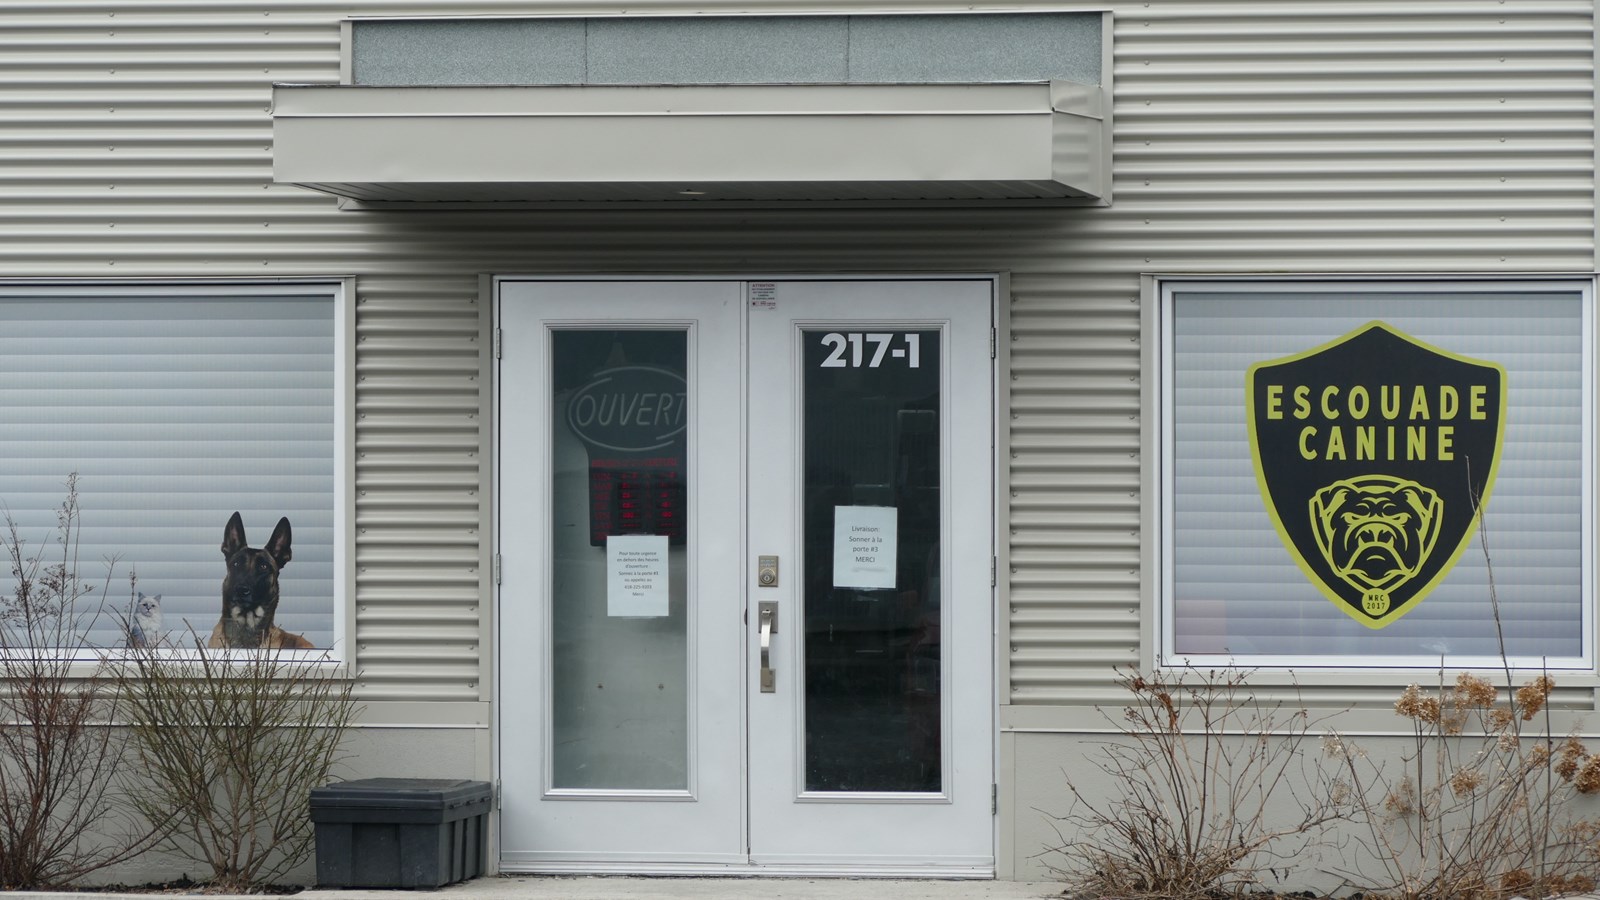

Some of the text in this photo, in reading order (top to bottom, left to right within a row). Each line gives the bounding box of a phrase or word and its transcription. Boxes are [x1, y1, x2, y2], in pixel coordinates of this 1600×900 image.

[820, 332, 920, 368] 217-1
[576, 392, 688, 426] OUVERT
[1267, 385, 1487, 420] ESCOUADE
[1298, 425, 1454, 461] CANINE
[848, 535, 871, 543] Sonner
[851, 525, 880, 533] Livraison:
[1366, 602, 1386, 610] 2017
[1368, 594, 1385, 602] MRC
